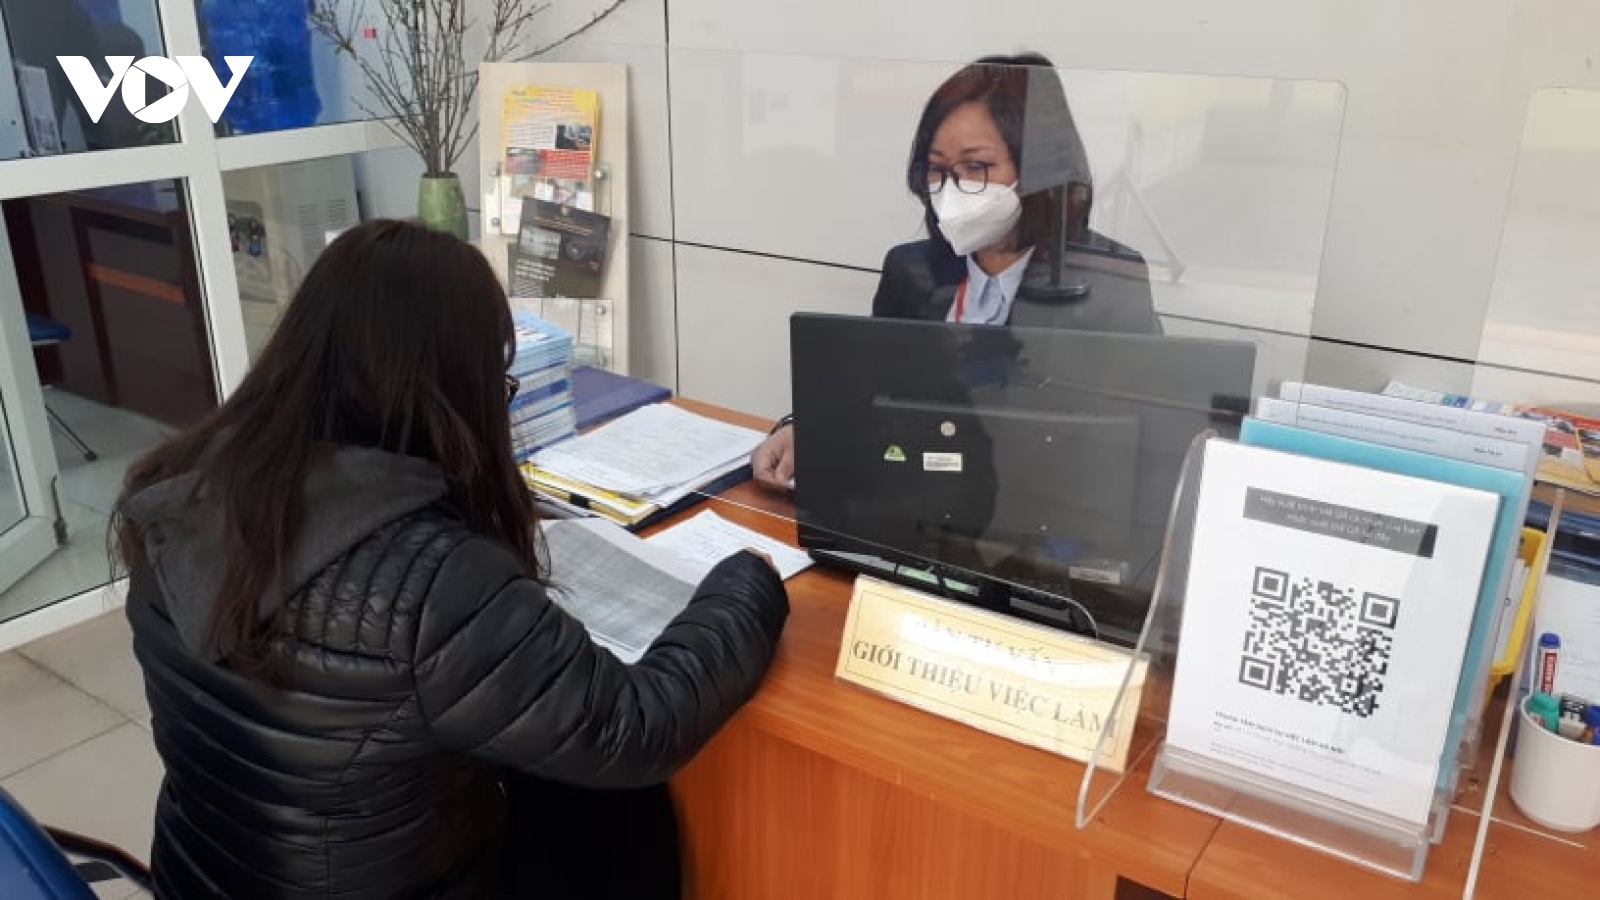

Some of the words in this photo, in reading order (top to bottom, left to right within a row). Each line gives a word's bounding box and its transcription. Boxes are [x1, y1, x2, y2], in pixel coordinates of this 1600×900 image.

[852, 640, 901, 672] GIỚI
[907, 656, 983, 695] THIỆU
[989, 682, 1049, 717] VIỆC
